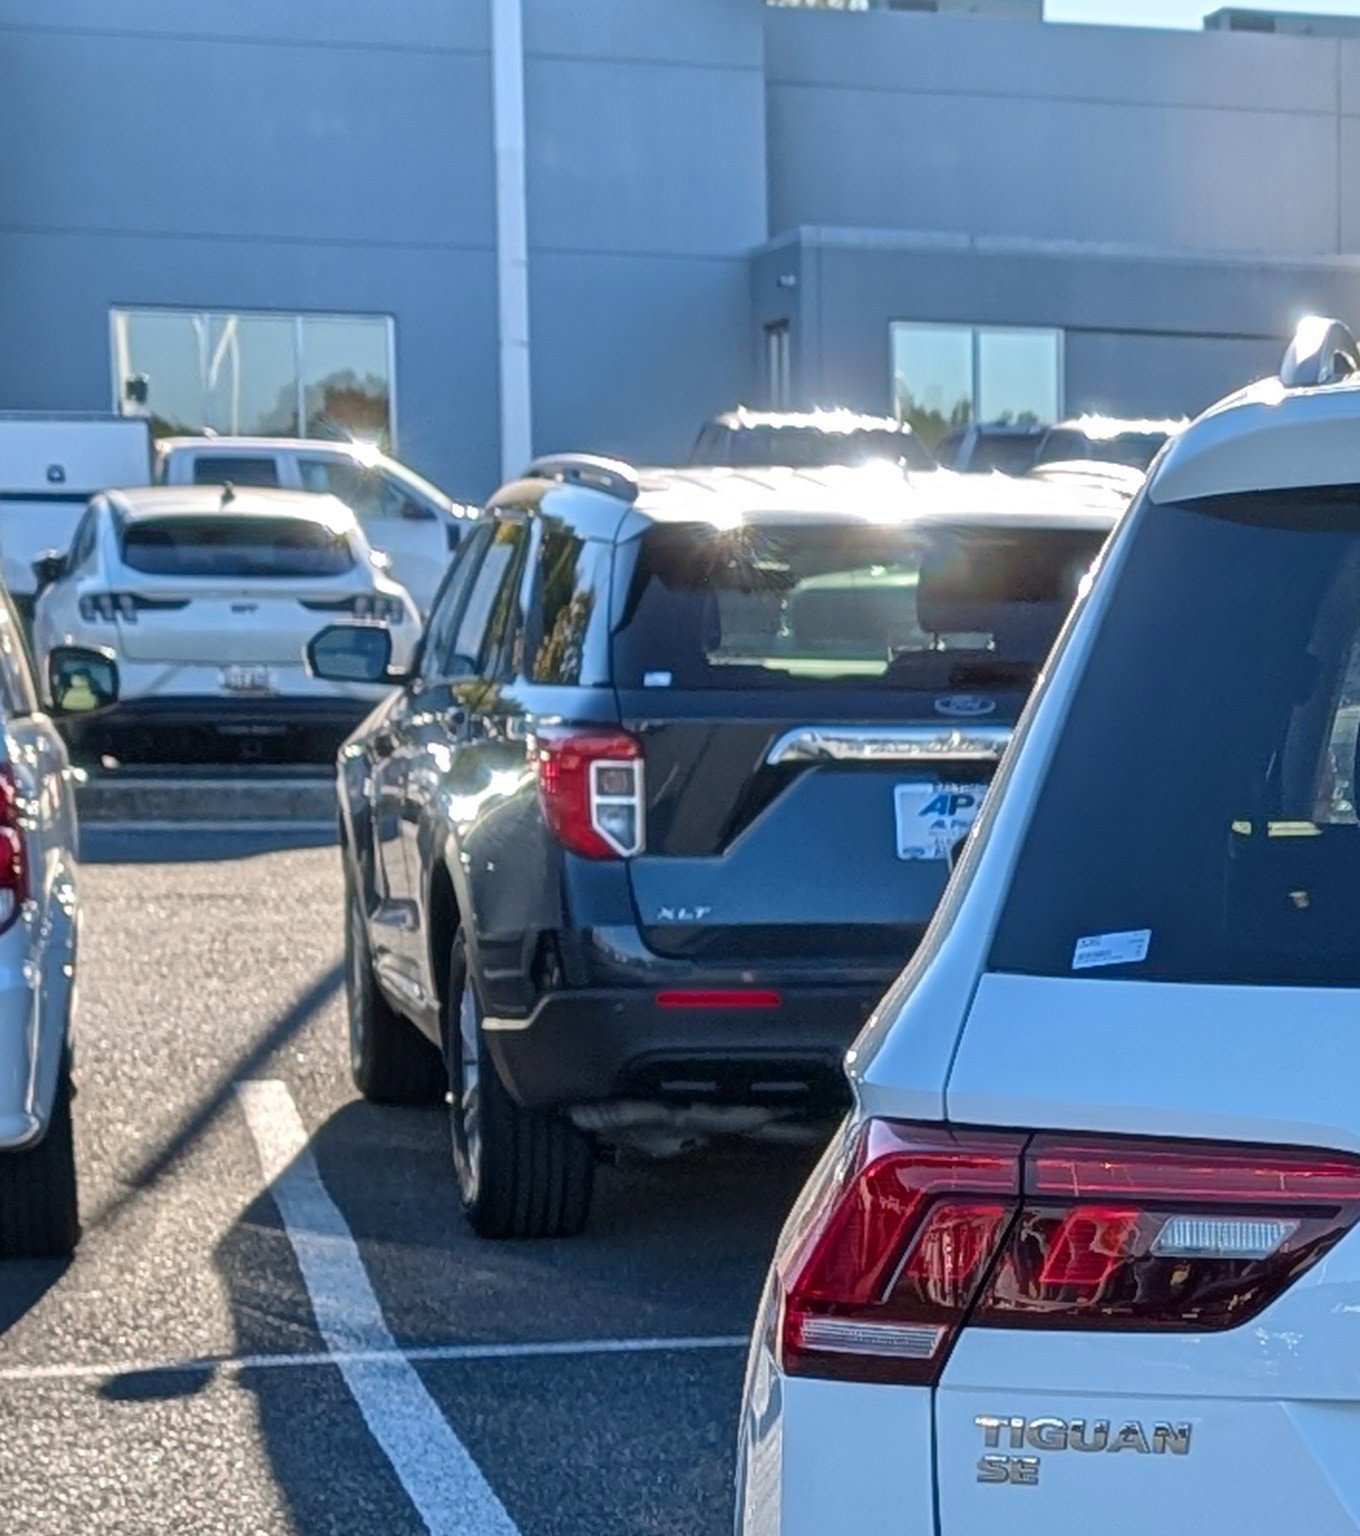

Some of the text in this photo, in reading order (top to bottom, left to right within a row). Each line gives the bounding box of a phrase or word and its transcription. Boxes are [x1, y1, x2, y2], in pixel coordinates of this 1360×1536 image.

[918, 793, 976, 817] AP
[657, 905, 712, 920] XLT
[974, 1412, 1193, 1455] TIGUAN
[976, 1453, 1041, 1486] SE
